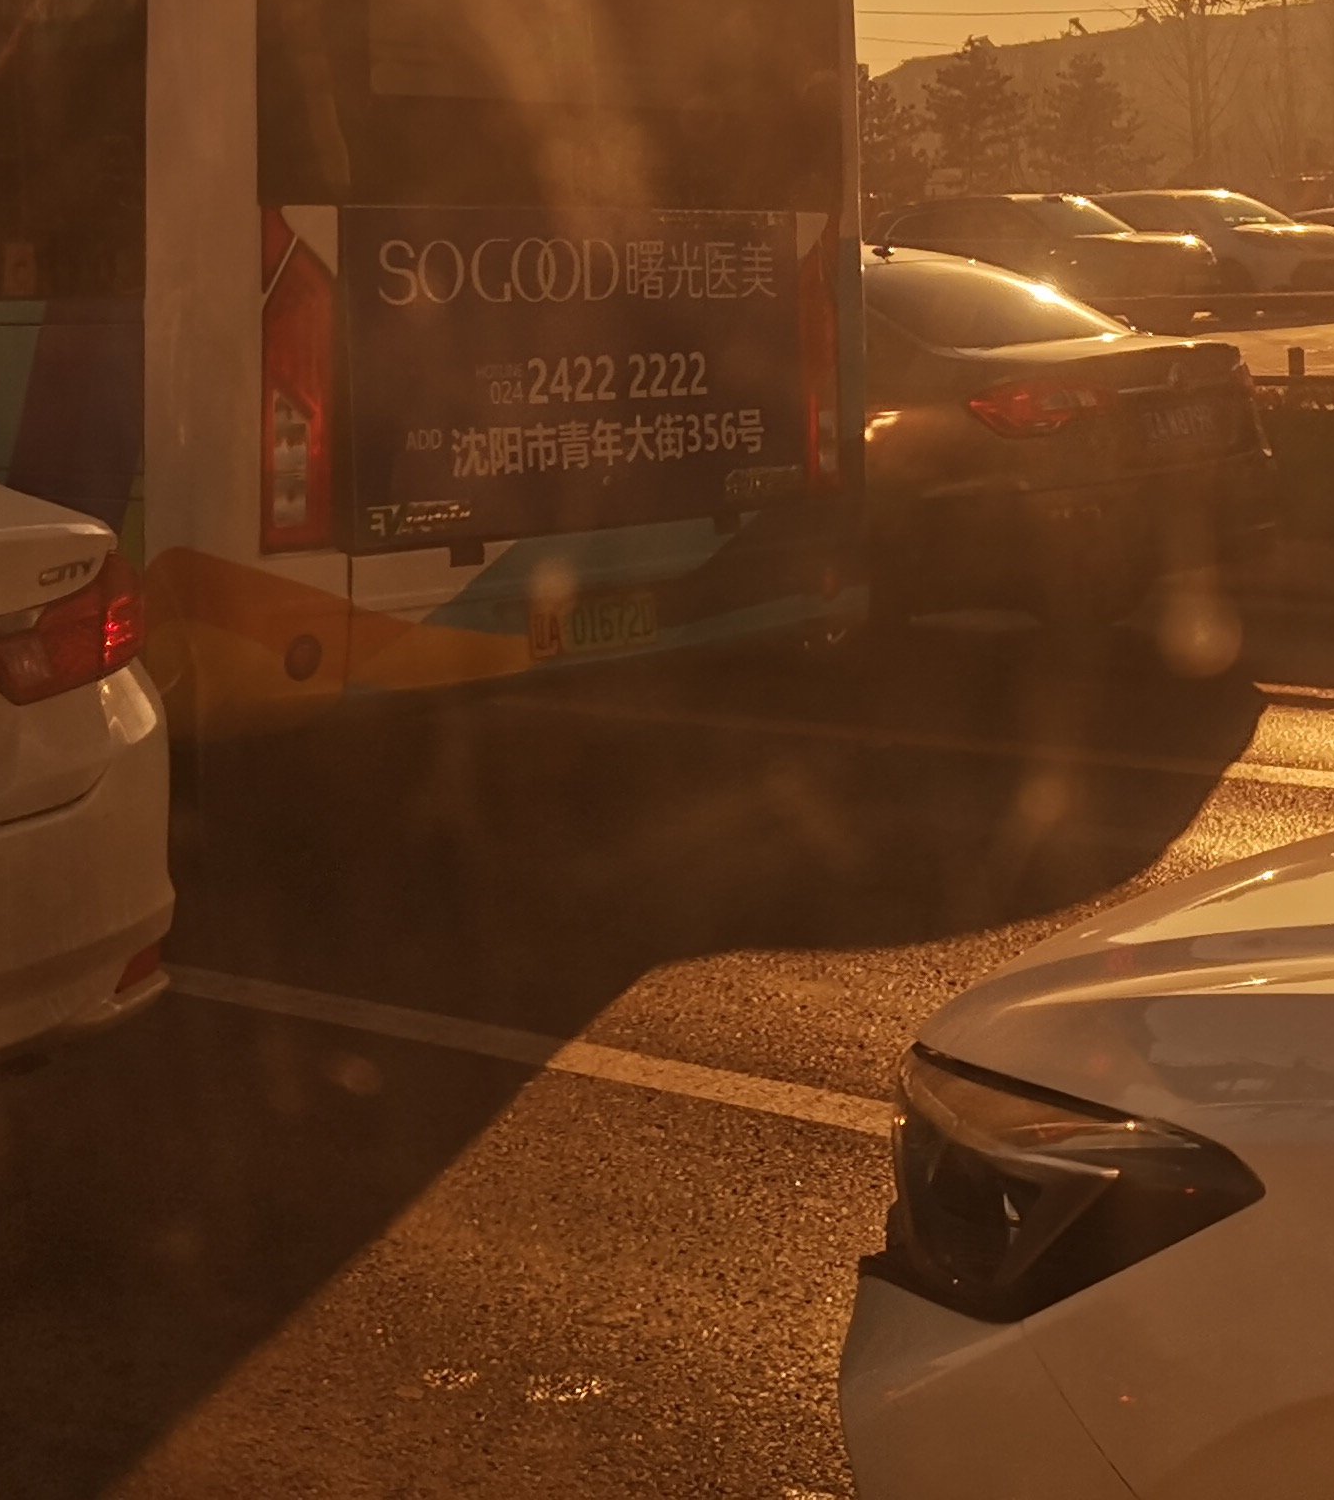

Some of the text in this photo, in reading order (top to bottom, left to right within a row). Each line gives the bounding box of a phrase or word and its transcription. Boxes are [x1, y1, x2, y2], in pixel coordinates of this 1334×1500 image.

[626, 240, 778, 300] 曙光医美
[490, 351, 708, 405] 024 2422 2222
[406, 408, 765, 478] ADD 沈阳市青年大街356号
